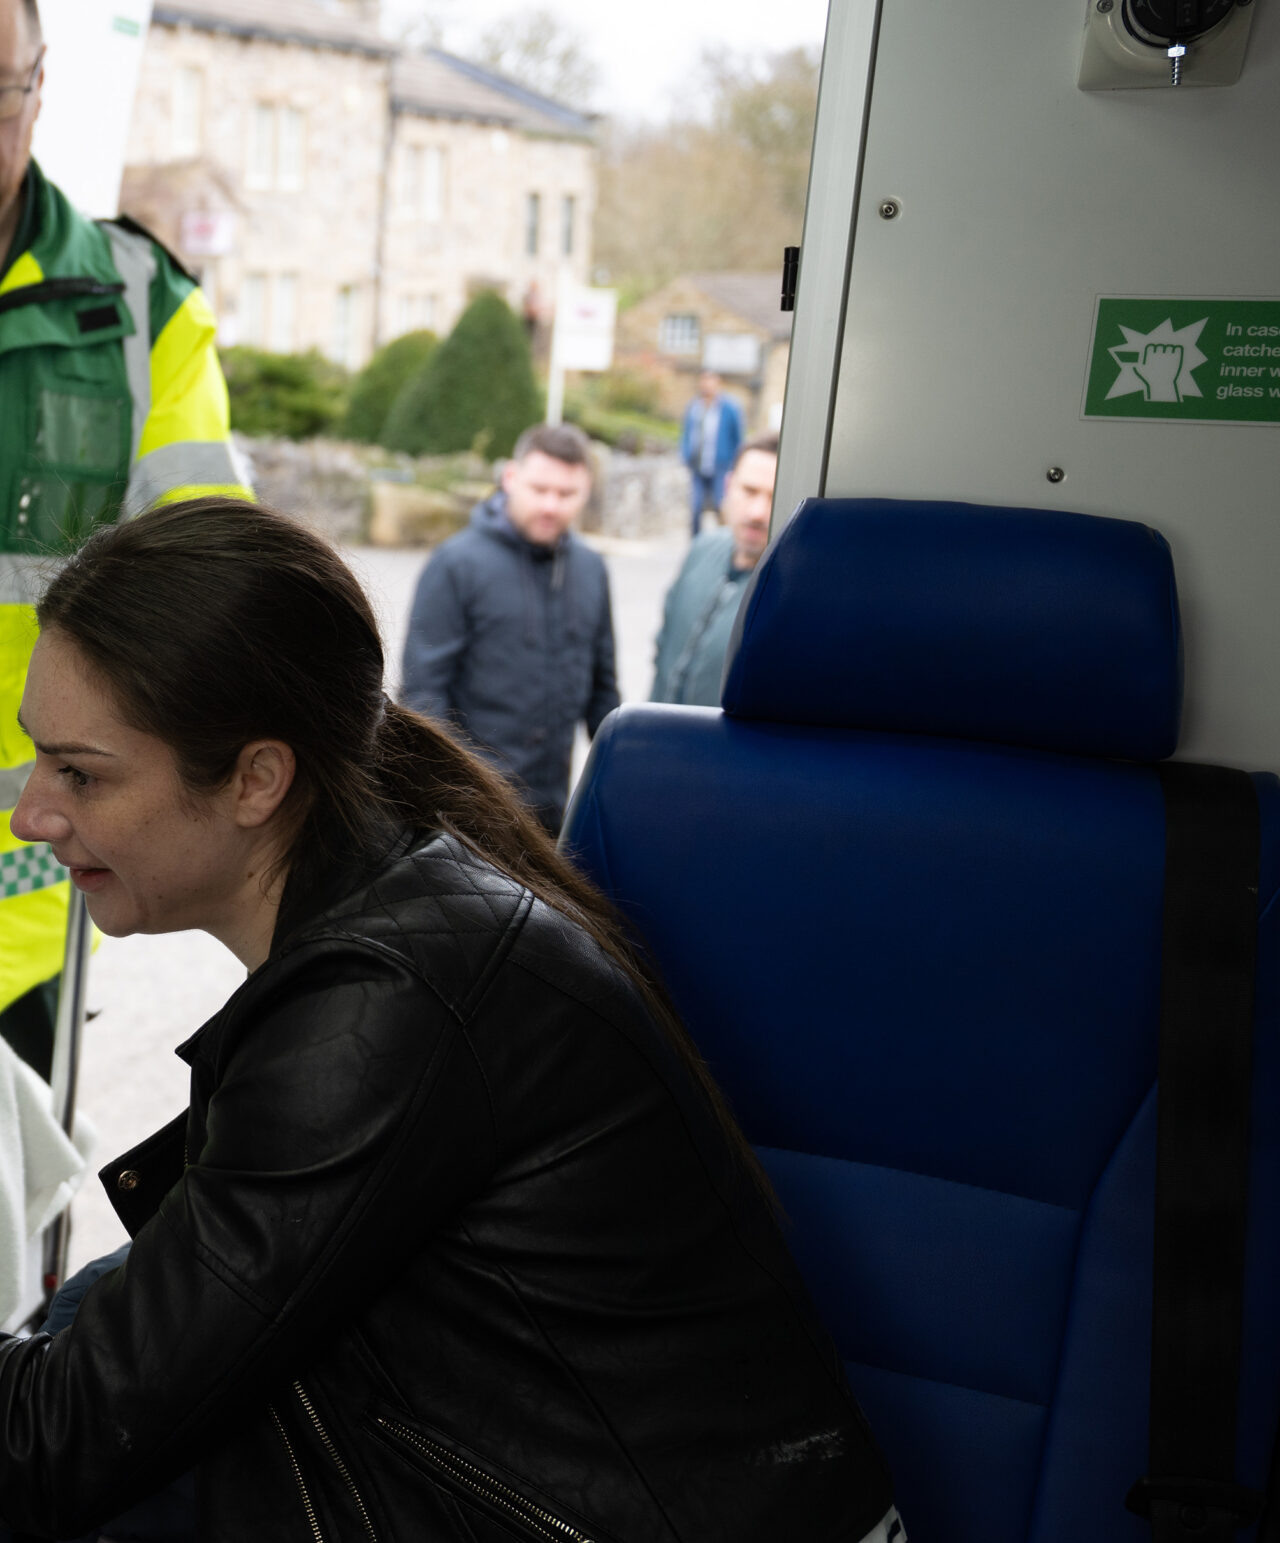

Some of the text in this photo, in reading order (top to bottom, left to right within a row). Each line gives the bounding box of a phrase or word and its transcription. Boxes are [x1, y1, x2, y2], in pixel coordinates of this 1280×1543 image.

[1227, 323, 1280, 337] In cas
[1220, 363, 1266, 377] inner
[1216, 384, 1264, 400] glass
